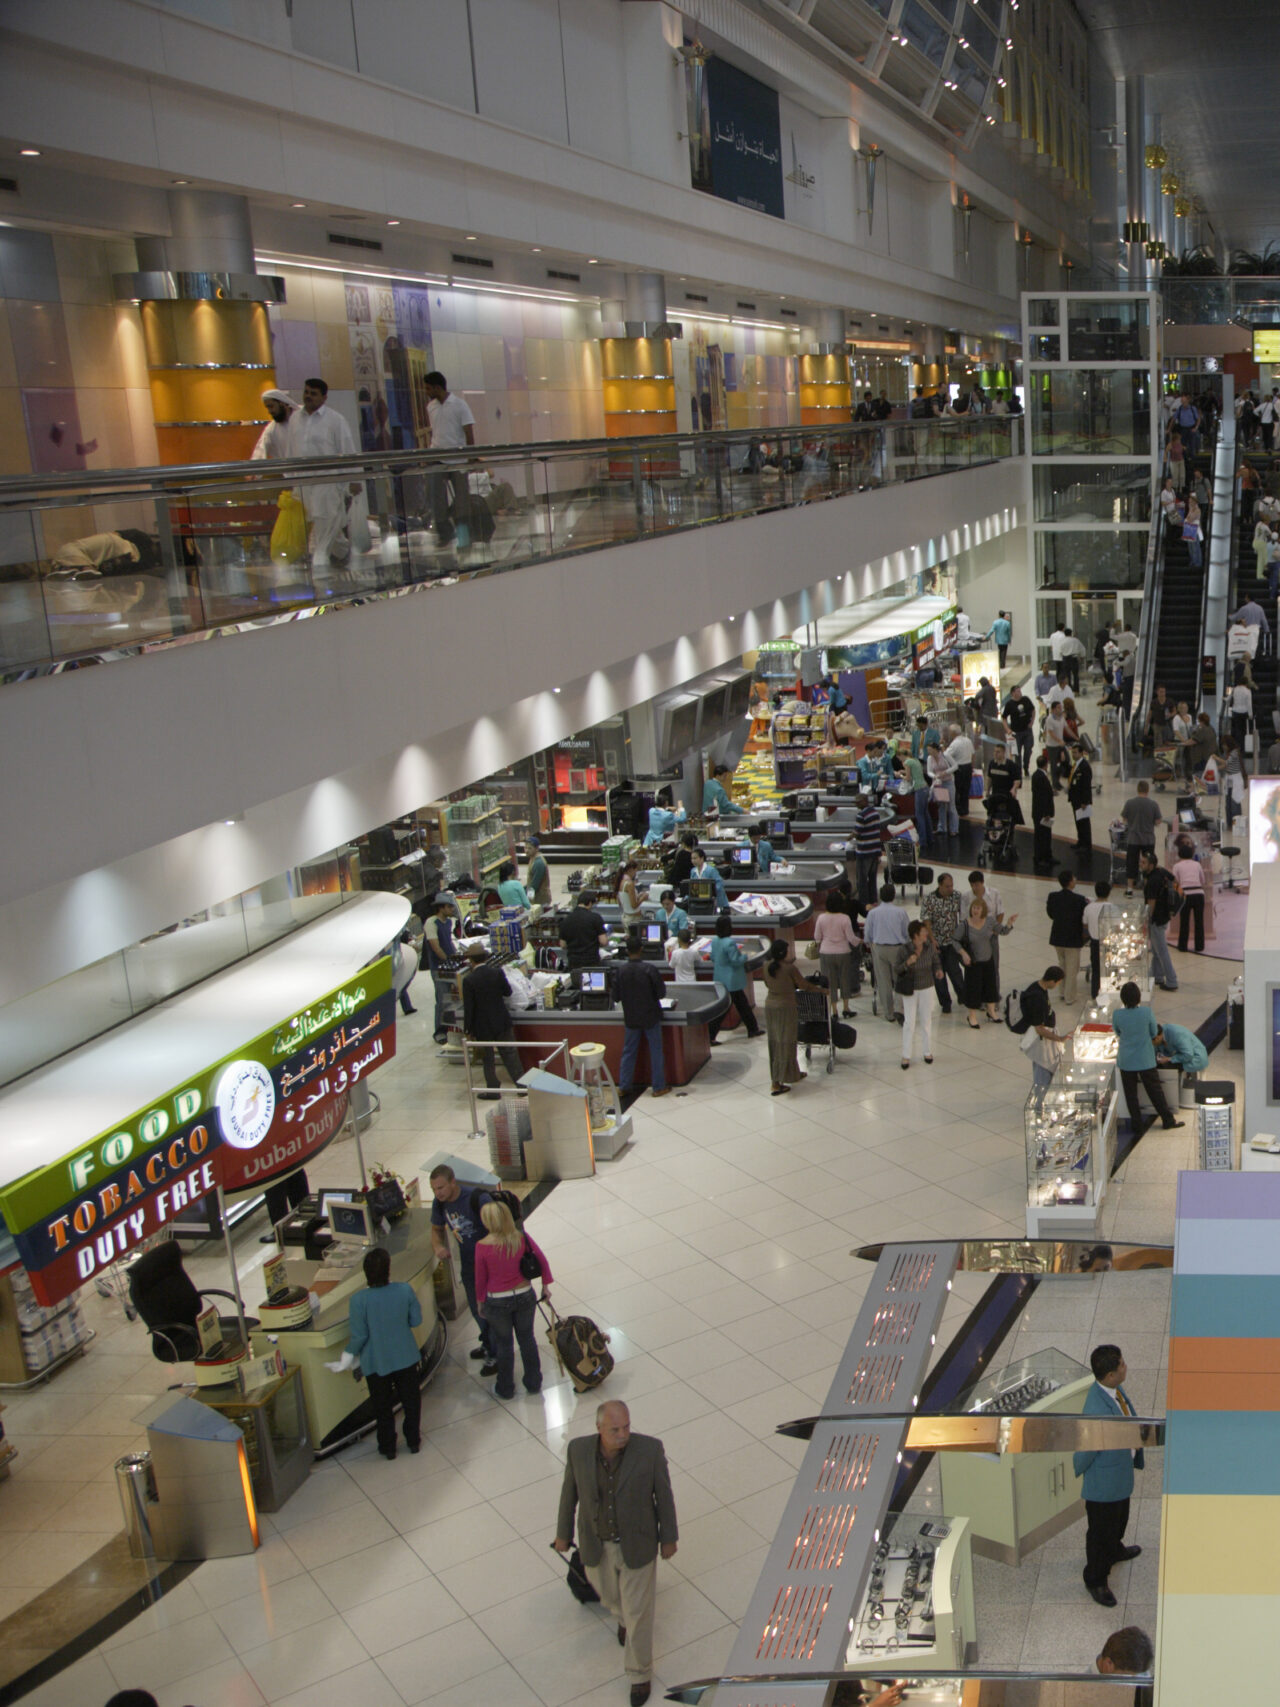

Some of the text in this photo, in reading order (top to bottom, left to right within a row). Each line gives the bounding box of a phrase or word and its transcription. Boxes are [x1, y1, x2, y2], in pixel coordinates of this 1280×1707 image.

[272, 987, 366, 1054] مواد غذائية
[329, 1011, 381, 1064] سجائر
[231, 1092, 272, 1141] DUBAI DUTY FREE
[284, 1039, 383, 1122] السوق الحرة
[68, 1087, 203, 1192] FOOD
[305, 1114, 334, 1144] Duty
[48, 1125, 209, 1252] TOBACCO
[77, 1160, 216, 1280] DUTY FREE
